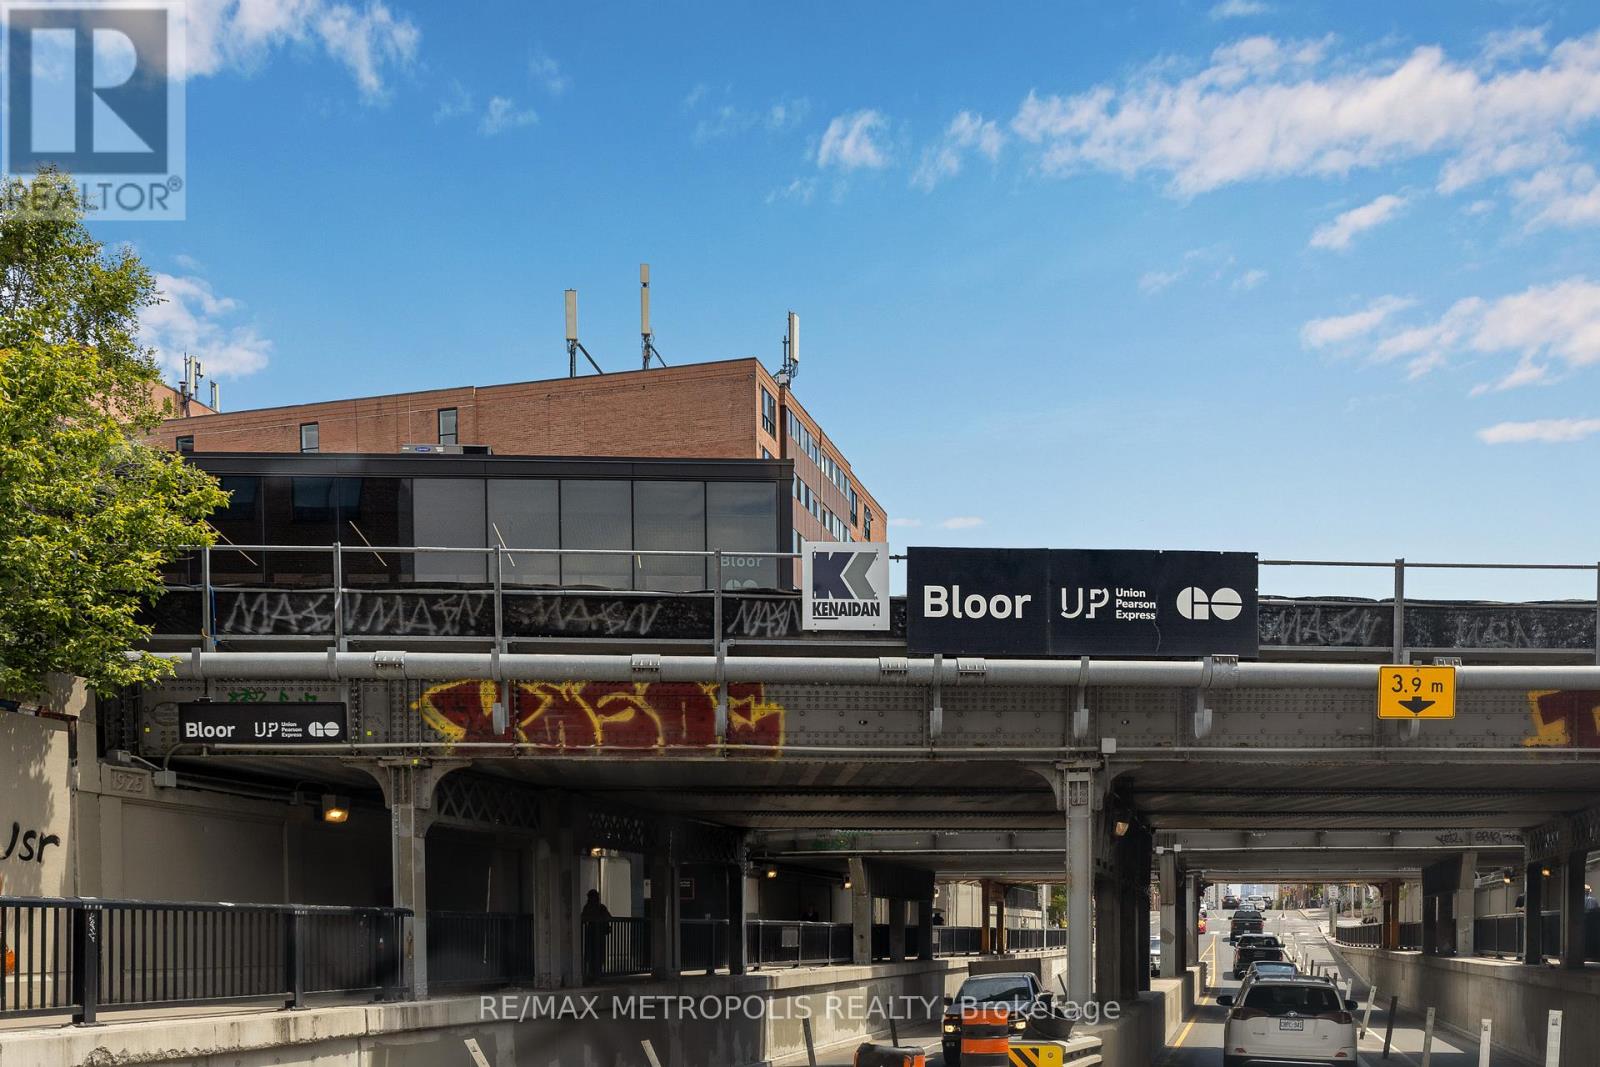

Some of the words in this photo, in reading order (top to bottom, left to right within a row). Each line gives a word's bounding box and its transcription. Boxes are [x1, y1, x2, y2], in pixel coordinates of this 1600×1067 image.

[720, 556, 763, 568] Bloor
[1115, 587, 1146, 598] Union
[812, 601, 881, 617] KENAIDAN
[923, 585, 1032, 619] Bloor
[1060, 587, 1110, 619] UP
[1115, 599, 1157, 609] Pearson
[1115, 609, 1156, 621] Express
[1391, 674, 1422, 693] 3.9
[1431, 681, 1444, 693] m
[185, 721, 236, 738] Bloor
[254, 721, 279, 738] UP
